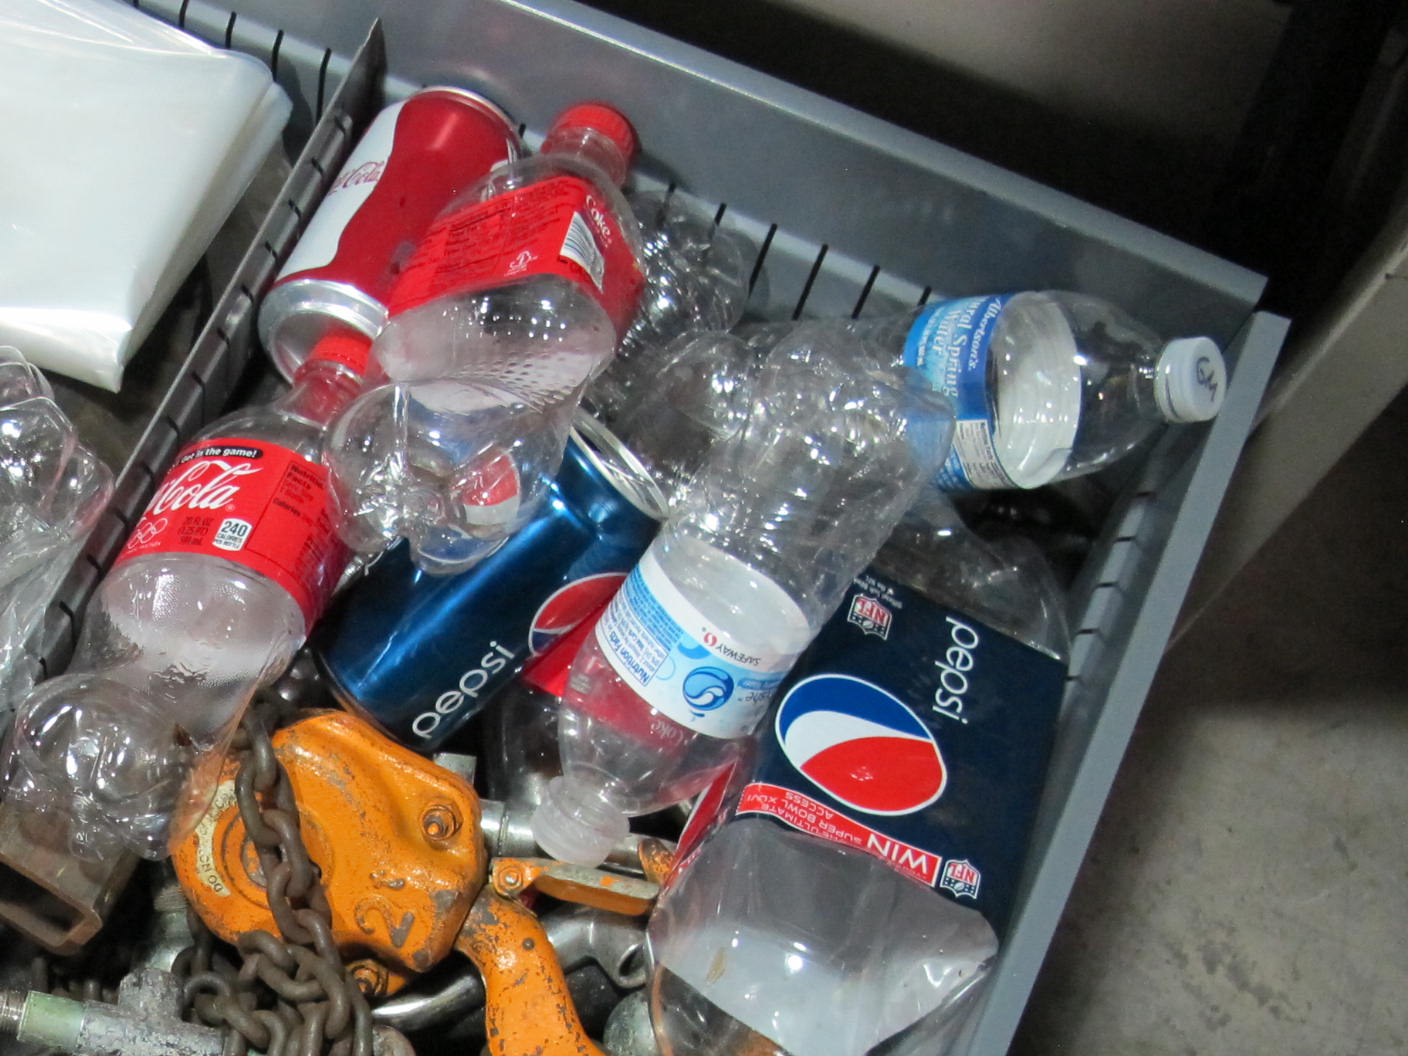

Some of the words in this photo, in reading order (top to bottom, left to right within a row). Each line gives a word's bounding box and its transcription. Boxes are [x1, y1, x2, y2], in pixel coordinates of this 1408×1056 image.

[933, 310, 961, 354] Water
[943, 334, 967, 397] Spring
[205, 447, 221, 456] the
[223, 448, 257, 459] game!
[220, 520, 247, 538] 240
[854, 598, 888, 627] NFL
[620, 647, 649, 682] Nutrition
[715, 643, 762, 666] SAFEWAY
[933, 616, 979, 724] pepsi
[412, 640, 516, 739] pepsi
[747, 793, 778, 805] XLVI
[783, 799, 817, 823] BOWL
[785, 791, 835, 821] ACCESS
[760, 804, 819, 837] ULTIMATE
[819, 821, 863, 845] SUPER
[867, 833, 928, 875] WIN
[208, 874, 225, 894] DO
[948, 861, 978, 886] NFL
